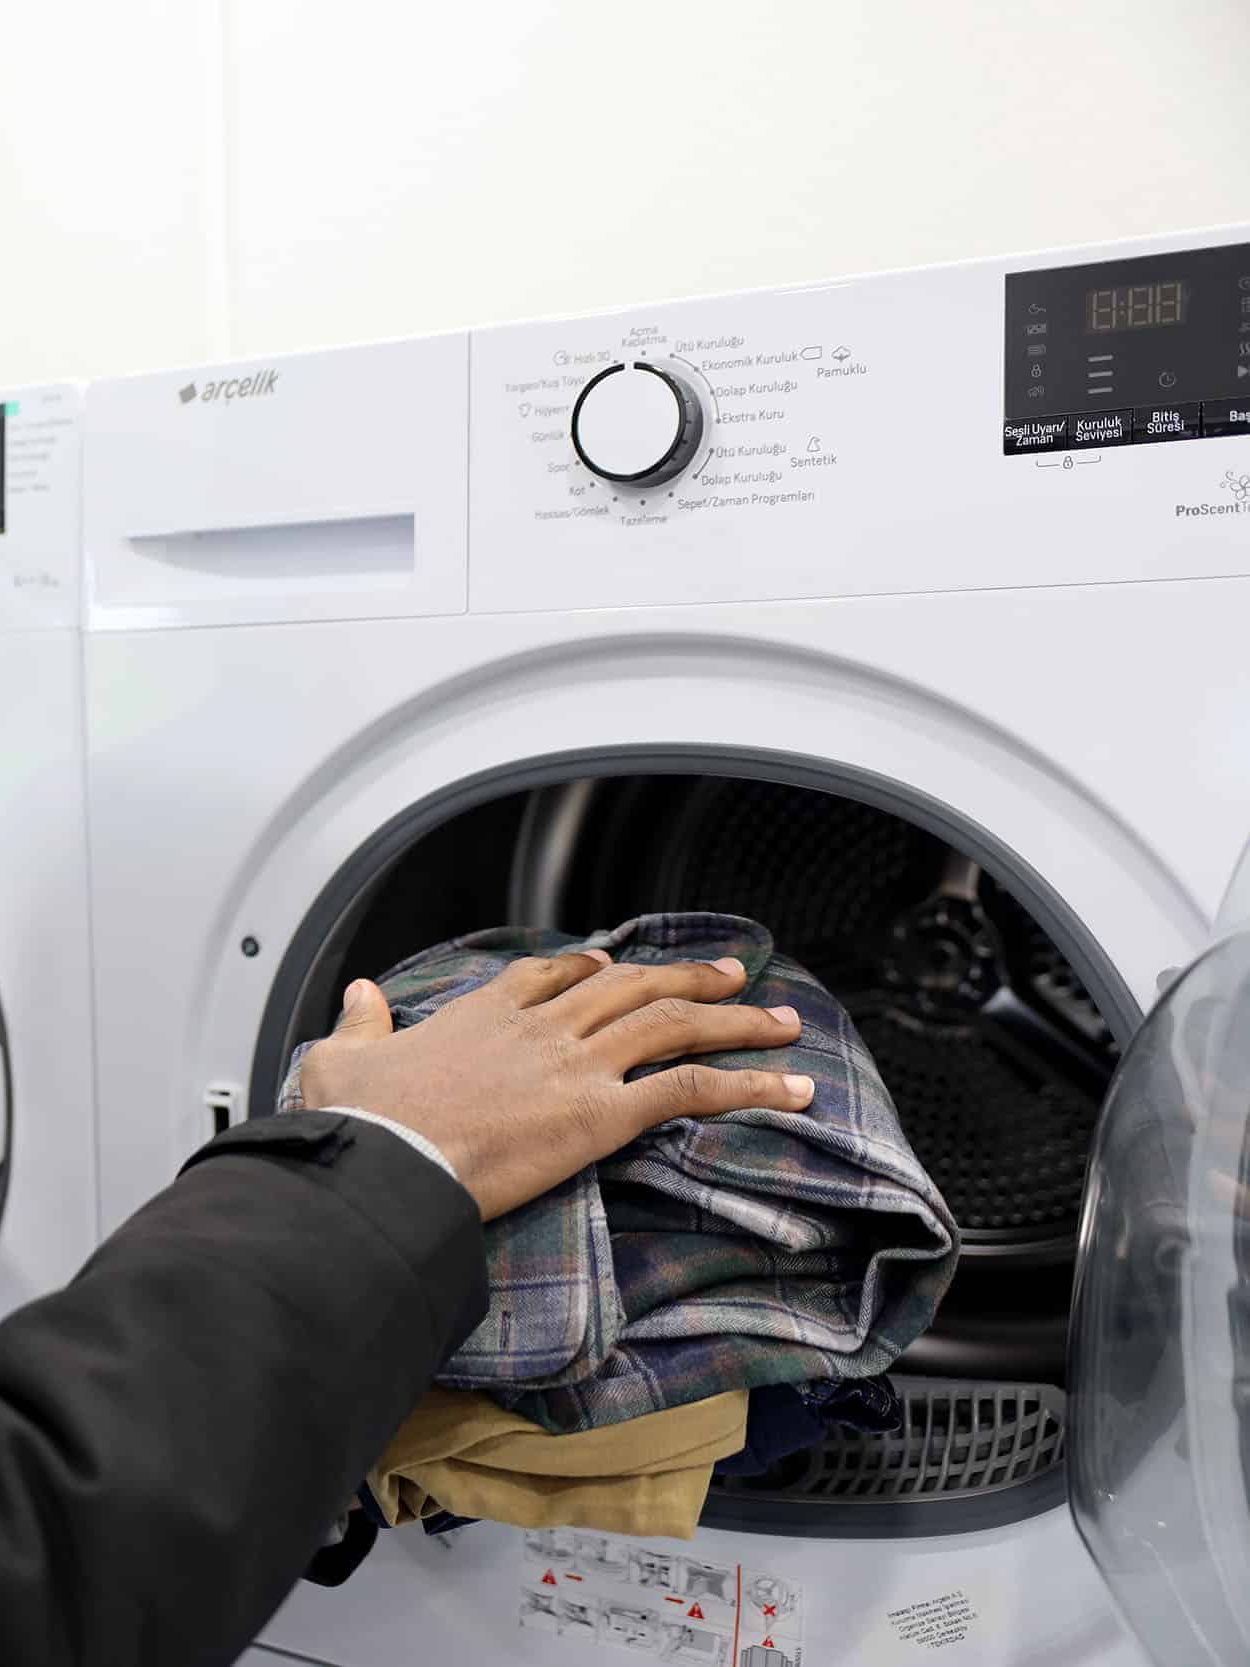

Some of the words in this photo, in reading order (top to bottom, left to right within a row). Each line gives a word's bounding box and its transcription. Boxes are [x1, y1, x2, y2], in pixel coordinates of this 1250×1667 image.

[697, 336, 745, 350] Kuruluğu
[702, 357, 753, 371] Ekonomik
[756, 350, 799, 365] Kuruluk
[816, 363, 868, 378] Pamuklu
[201, 367, 279, 405] arçelik
[716, 385, 747, 398] Dolap
[749, 380, 798, 394] Kuruluğu
[721, 411, 756, 424] Ekstra
[758, 407, 785, 421] Kuru
[1077, 415, 1122, 431] Kuruluk
[1152, 411, 1180, 425] Bitiş
[1005, 424, 1030, 438] Sesli
[1146, 419, 1185, 434] Süresi
[1015, 434, 1054, 447] Zaman
[1075, 427, 1123, 442] Seviyesi
[737, 443, 787, 457] Kuruluğu
[790, 455, 838, 468] Sentetik
[701, 475, 731, 487] Dolap
[734, 470, 783, 484] Kuruluğu
[752, 489, 815, 506] Programları
